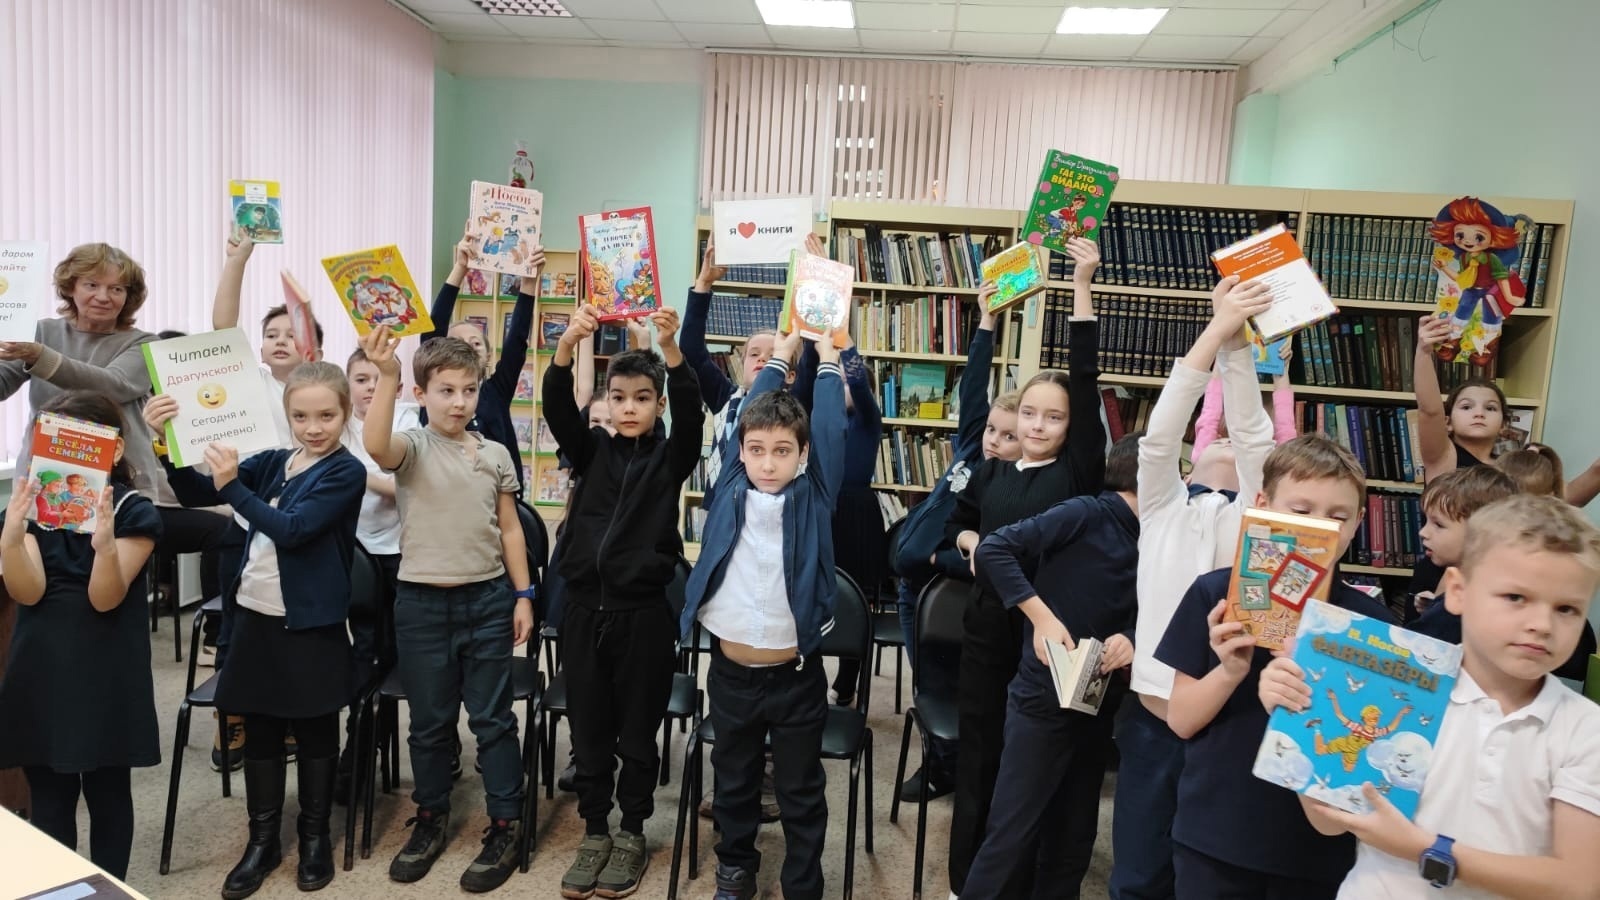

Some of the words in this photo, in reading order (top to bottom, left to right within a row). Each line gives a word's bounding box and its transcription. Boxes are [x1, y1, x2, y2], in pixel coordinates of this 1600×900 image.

[1059, 167, 1075, 179] ГДЕ
[1077, 172, 1095, 183] ЭТО
[1051, 174, 1105, 197] ВИДАНО...
[729, 228, 737, 236] Я
[758, 226, 793, 235] КНИГИ
[1, 249, 34, 259] даром
[168, 344, 232, 364] Читаем
[167, 361, 244, 387] Драгунского!
[191, 410, 237, 428] Сегодня
[239, 409, 247, 417] и
[190, 423, 257, 446] ежедневно!
[48, 446, 100, 464] СЕМЕЙКА
[1367, 634, 1411, 658] Носов
[1311, 636, 1440, 693] ФАНТАЗЁРЫ
